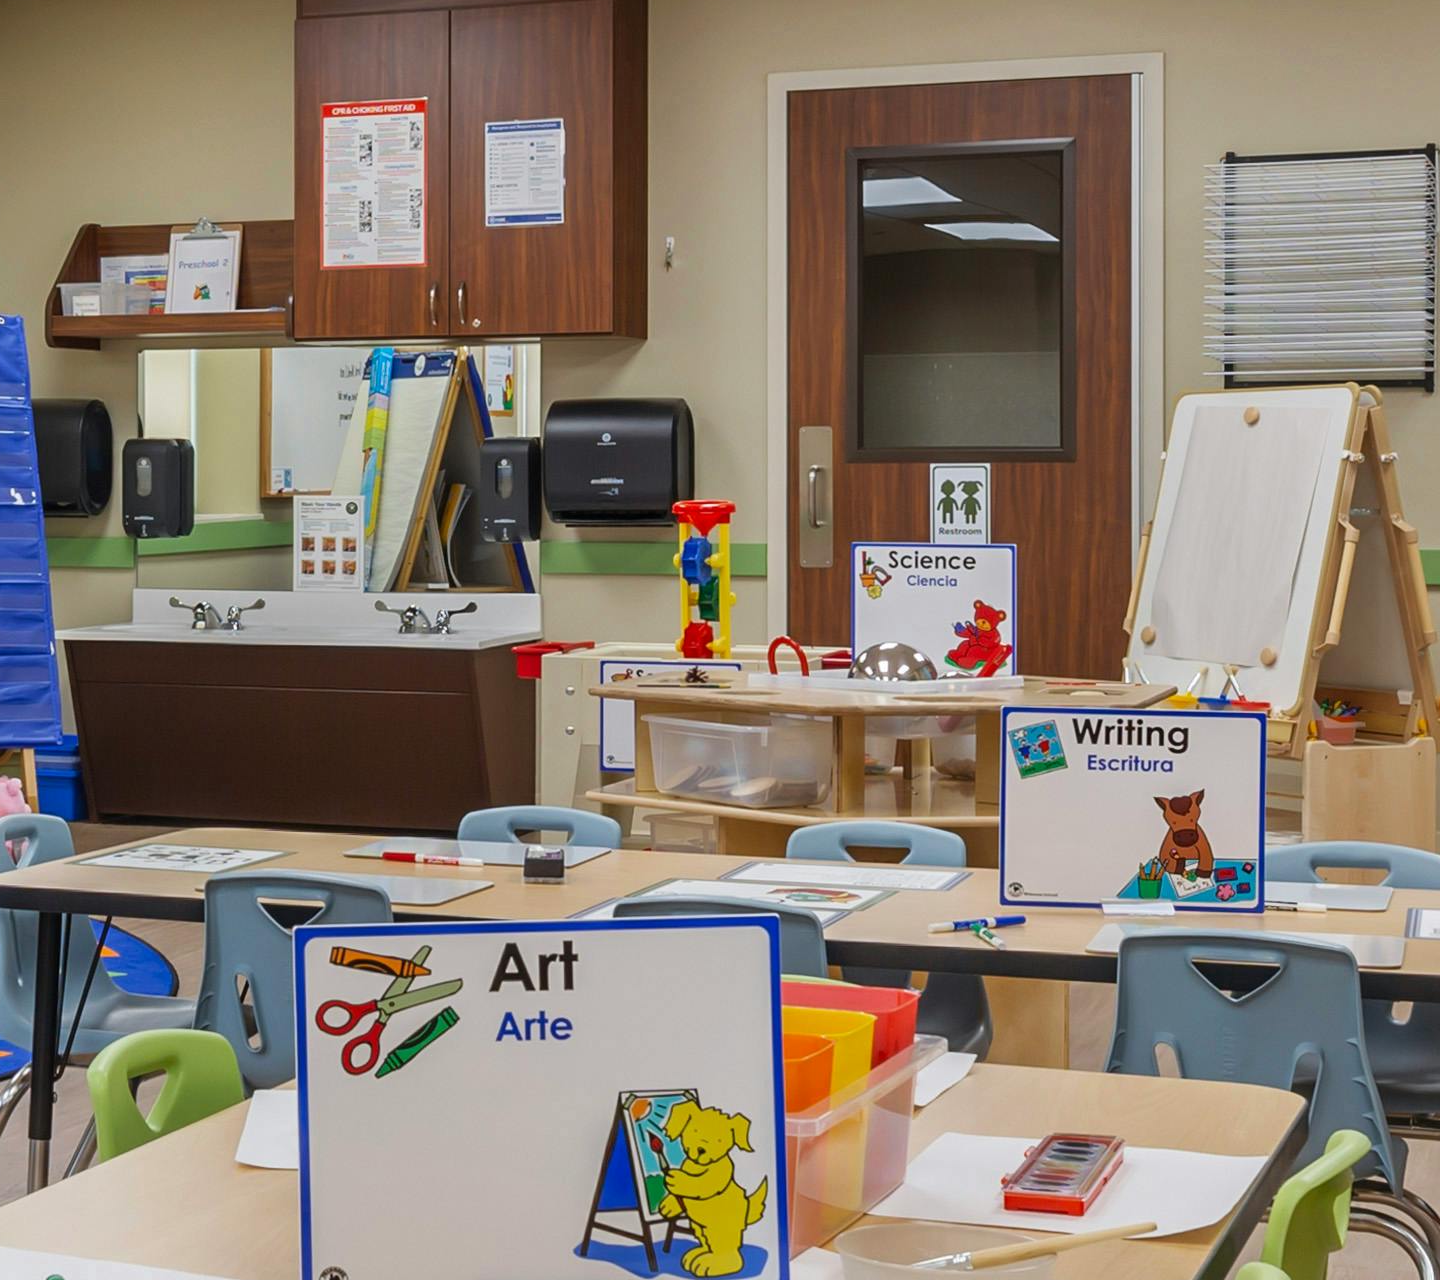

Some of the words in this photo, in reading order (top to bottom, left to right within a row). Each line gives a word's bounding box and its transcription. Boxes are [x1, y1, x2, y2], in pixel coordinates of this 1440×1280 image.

[178, 258, 219, 270] Preschool
[938, 527, 982, 536] Restroom
[888, 550, 977, 570] Science
[906, 575, 958, 587] Ciencia
[1072, 718, 1189, 754] Writing
[1087, 755, 1174, 773] Escritura
[489, 940, 579, 993] Art
[495, 1010, 574, 1042] Arte
